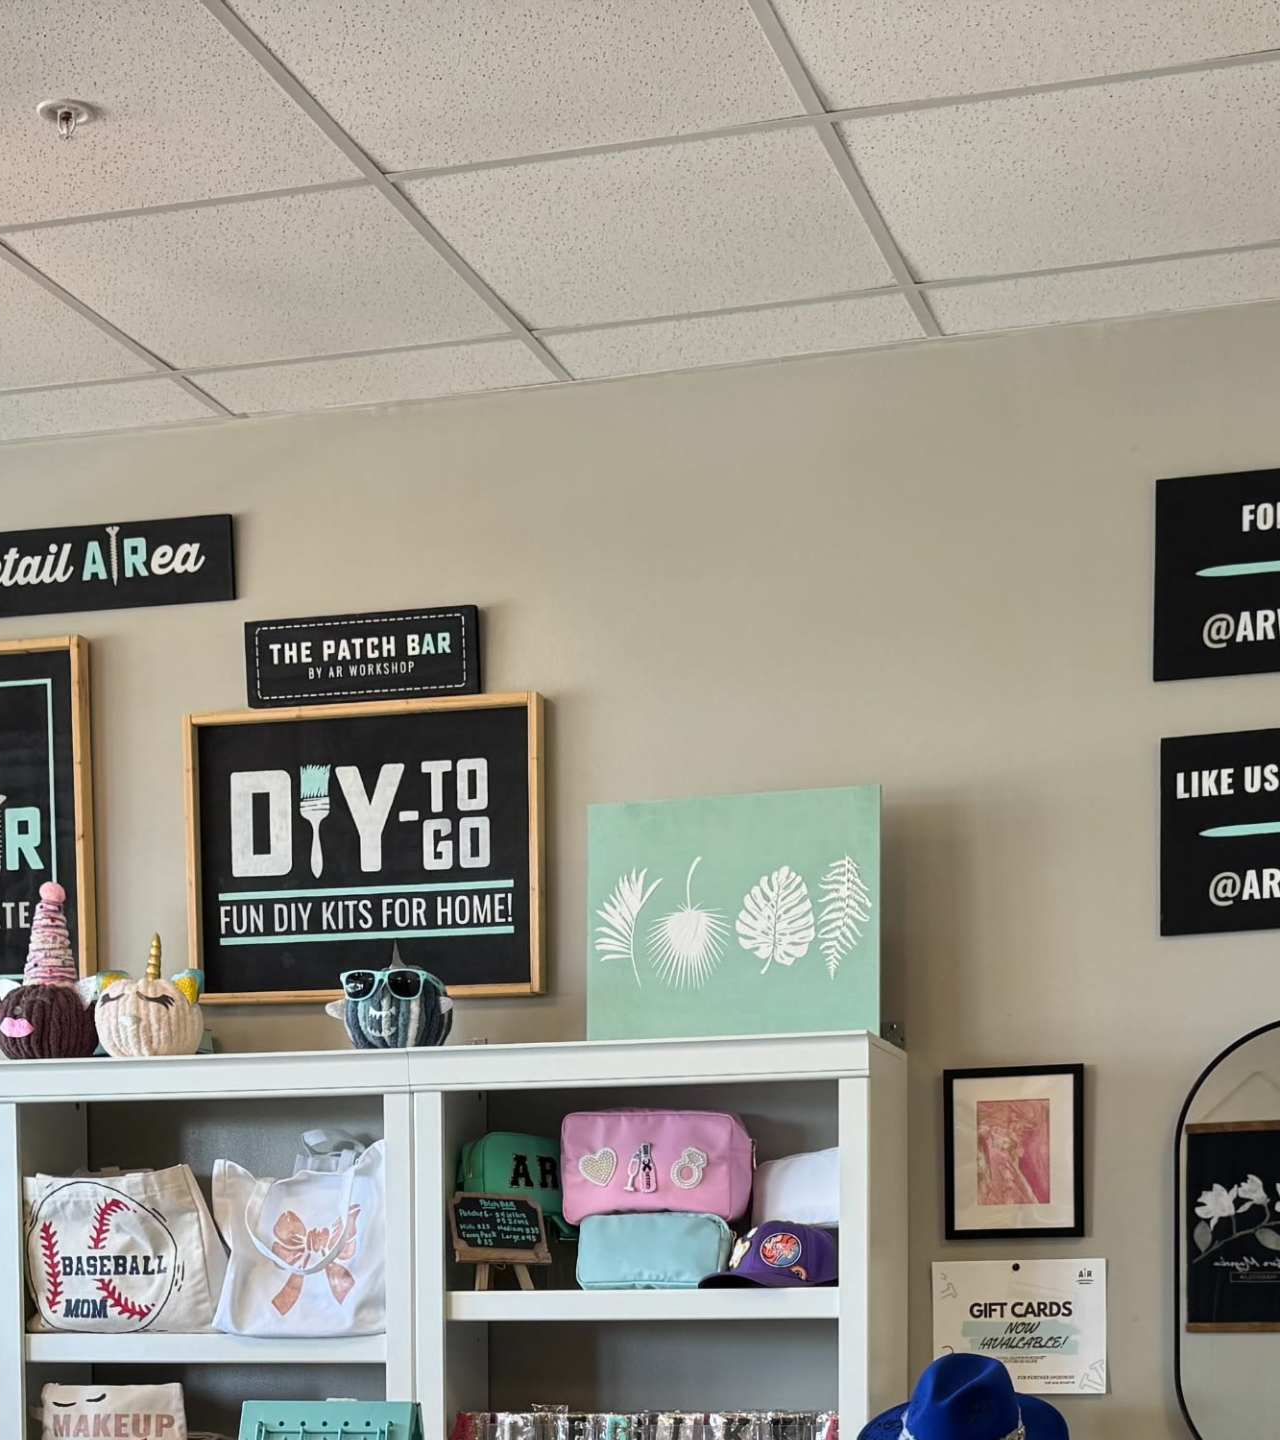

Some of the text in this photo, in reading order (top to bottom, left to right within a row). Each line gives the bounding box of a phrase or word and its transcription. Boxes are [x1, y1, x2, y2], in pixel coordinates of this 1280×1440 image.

[269, 632, 452, 665] THE PATCH BAR
[308, 661, 415, 680] BY AR WORKSHOP
[1176, 767, 1234, 799] LIKE
[1244, 763, 1279, 793] US
[220, 893, 513, 934] FUN DIY KITS FOR HOME!
[62, 1255, 168, 1277] BASEBALL
[63, 1299, 109, 1319] MOM
[970, 1301, 1072, 1319] GIFT CARDS
[1004, 1321, 1040, 1335] NOW
[52, 1414, 176, 1437] MAKEUP
